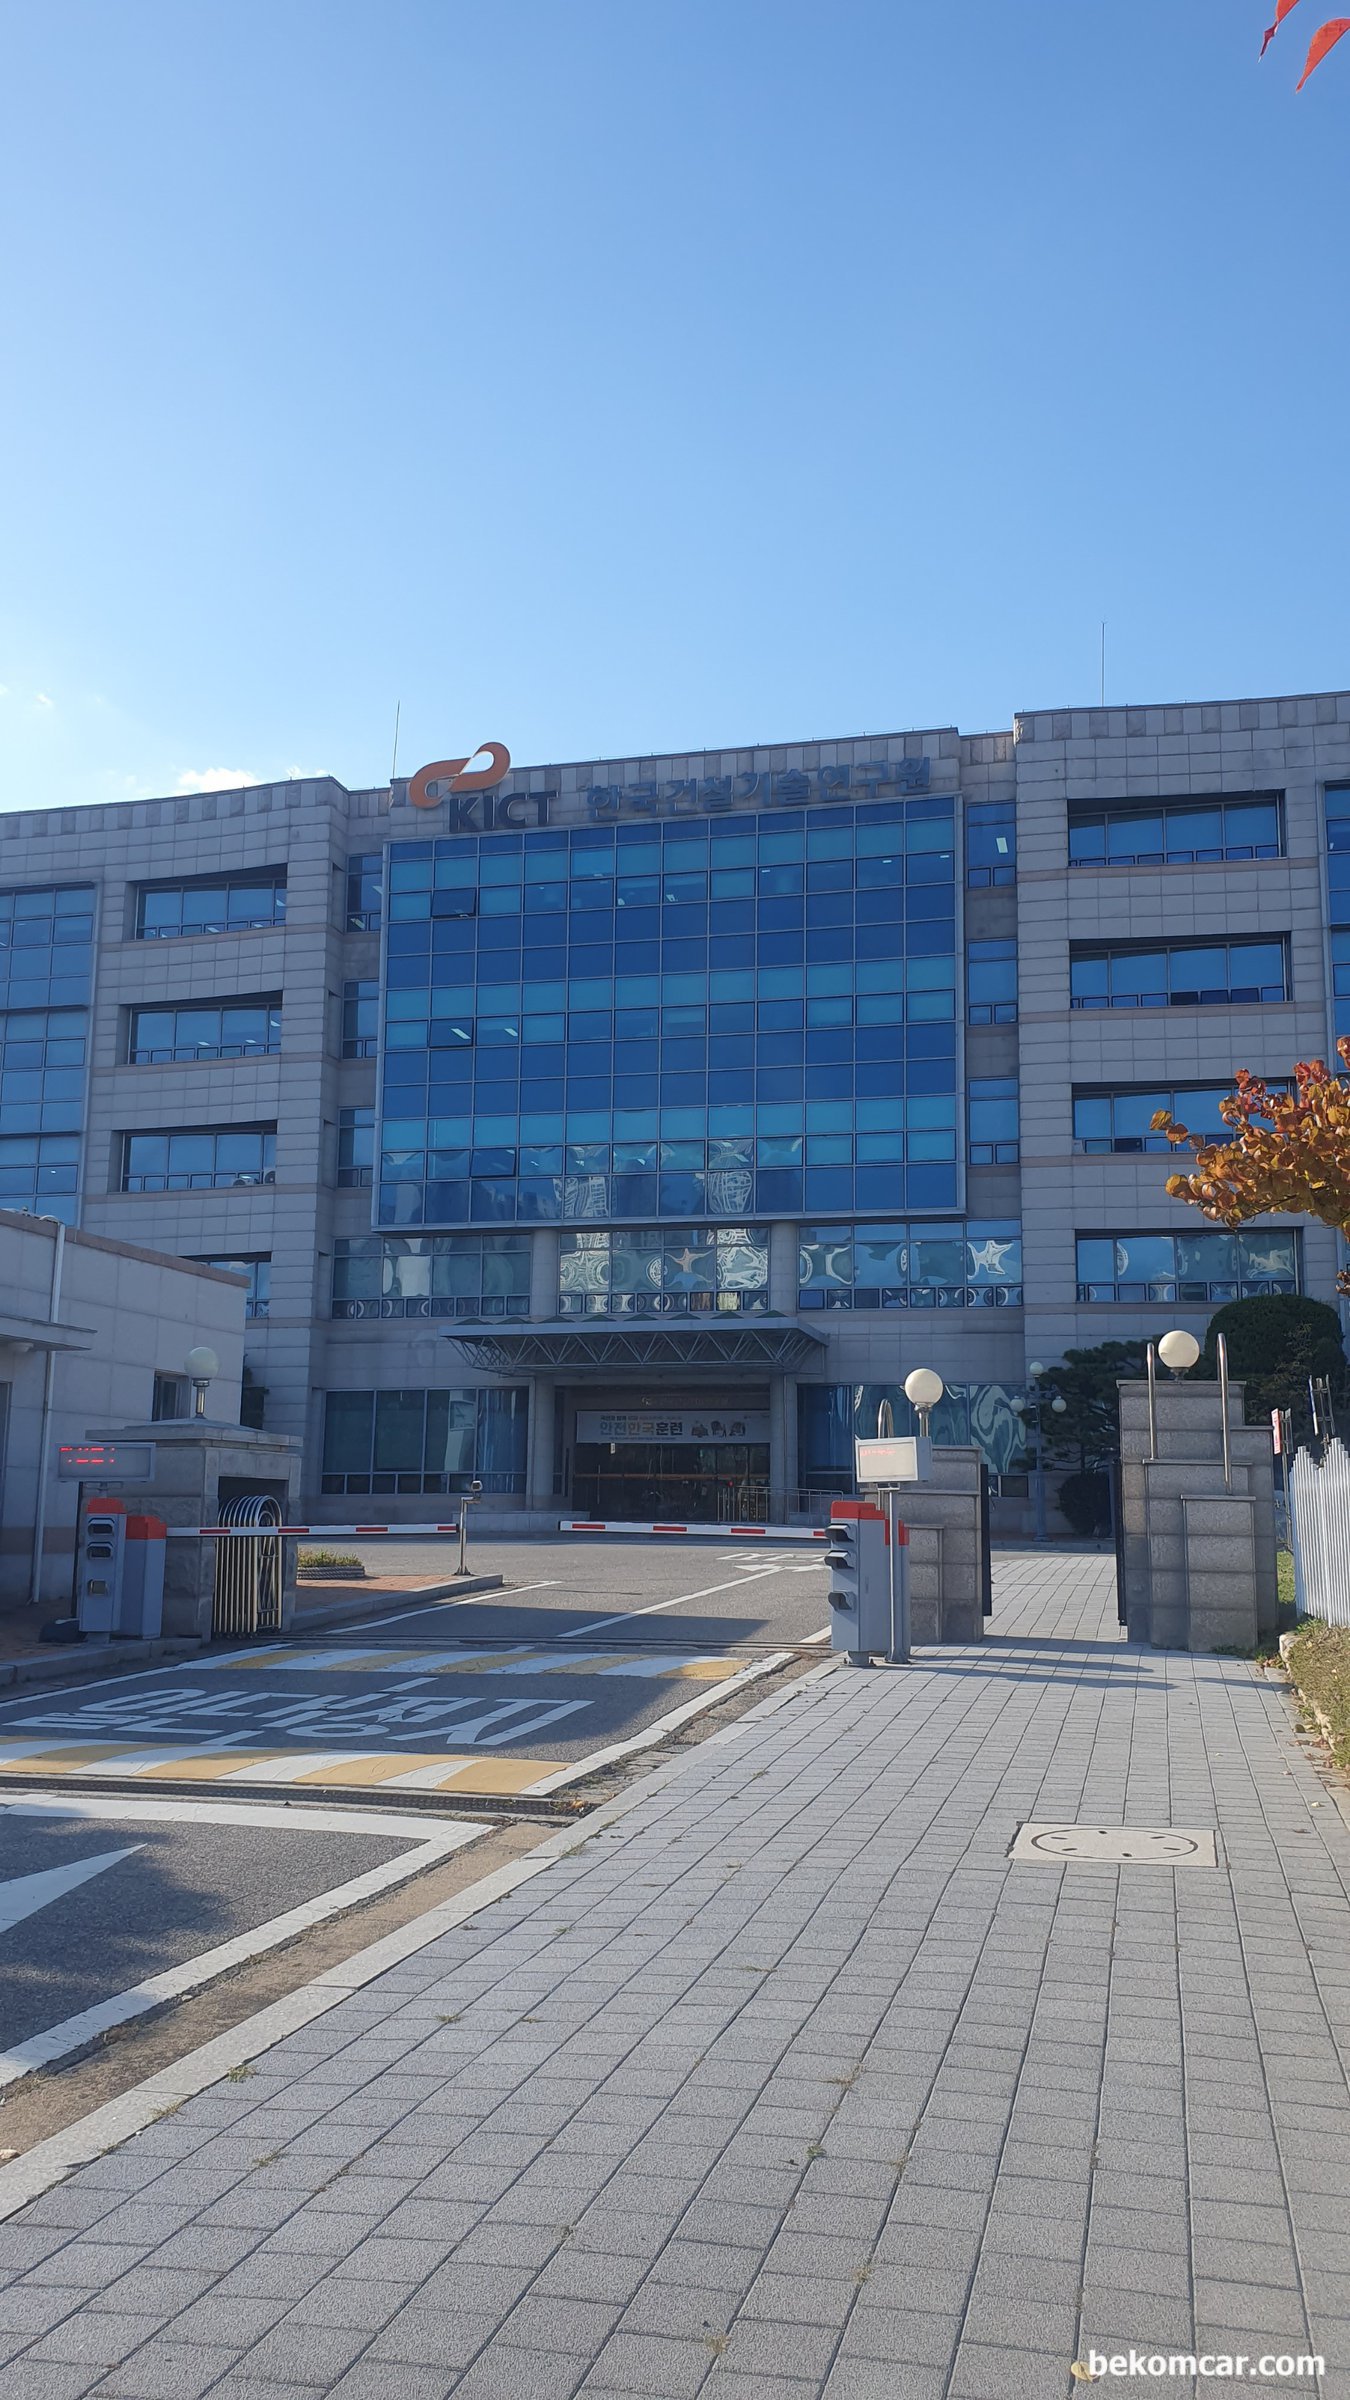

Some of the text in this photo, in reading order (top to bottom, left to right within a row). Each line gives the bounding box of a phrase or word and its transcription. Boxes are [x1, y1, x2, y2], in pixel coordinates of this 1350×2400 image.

[450, 790, 559, 833] KICT
[585, 756, 930, 822] 한국건설기술연구원
[600, 1421, 684, 1436] 안전한국훈련
[2, 1687, 596, 1746] 일단정지
